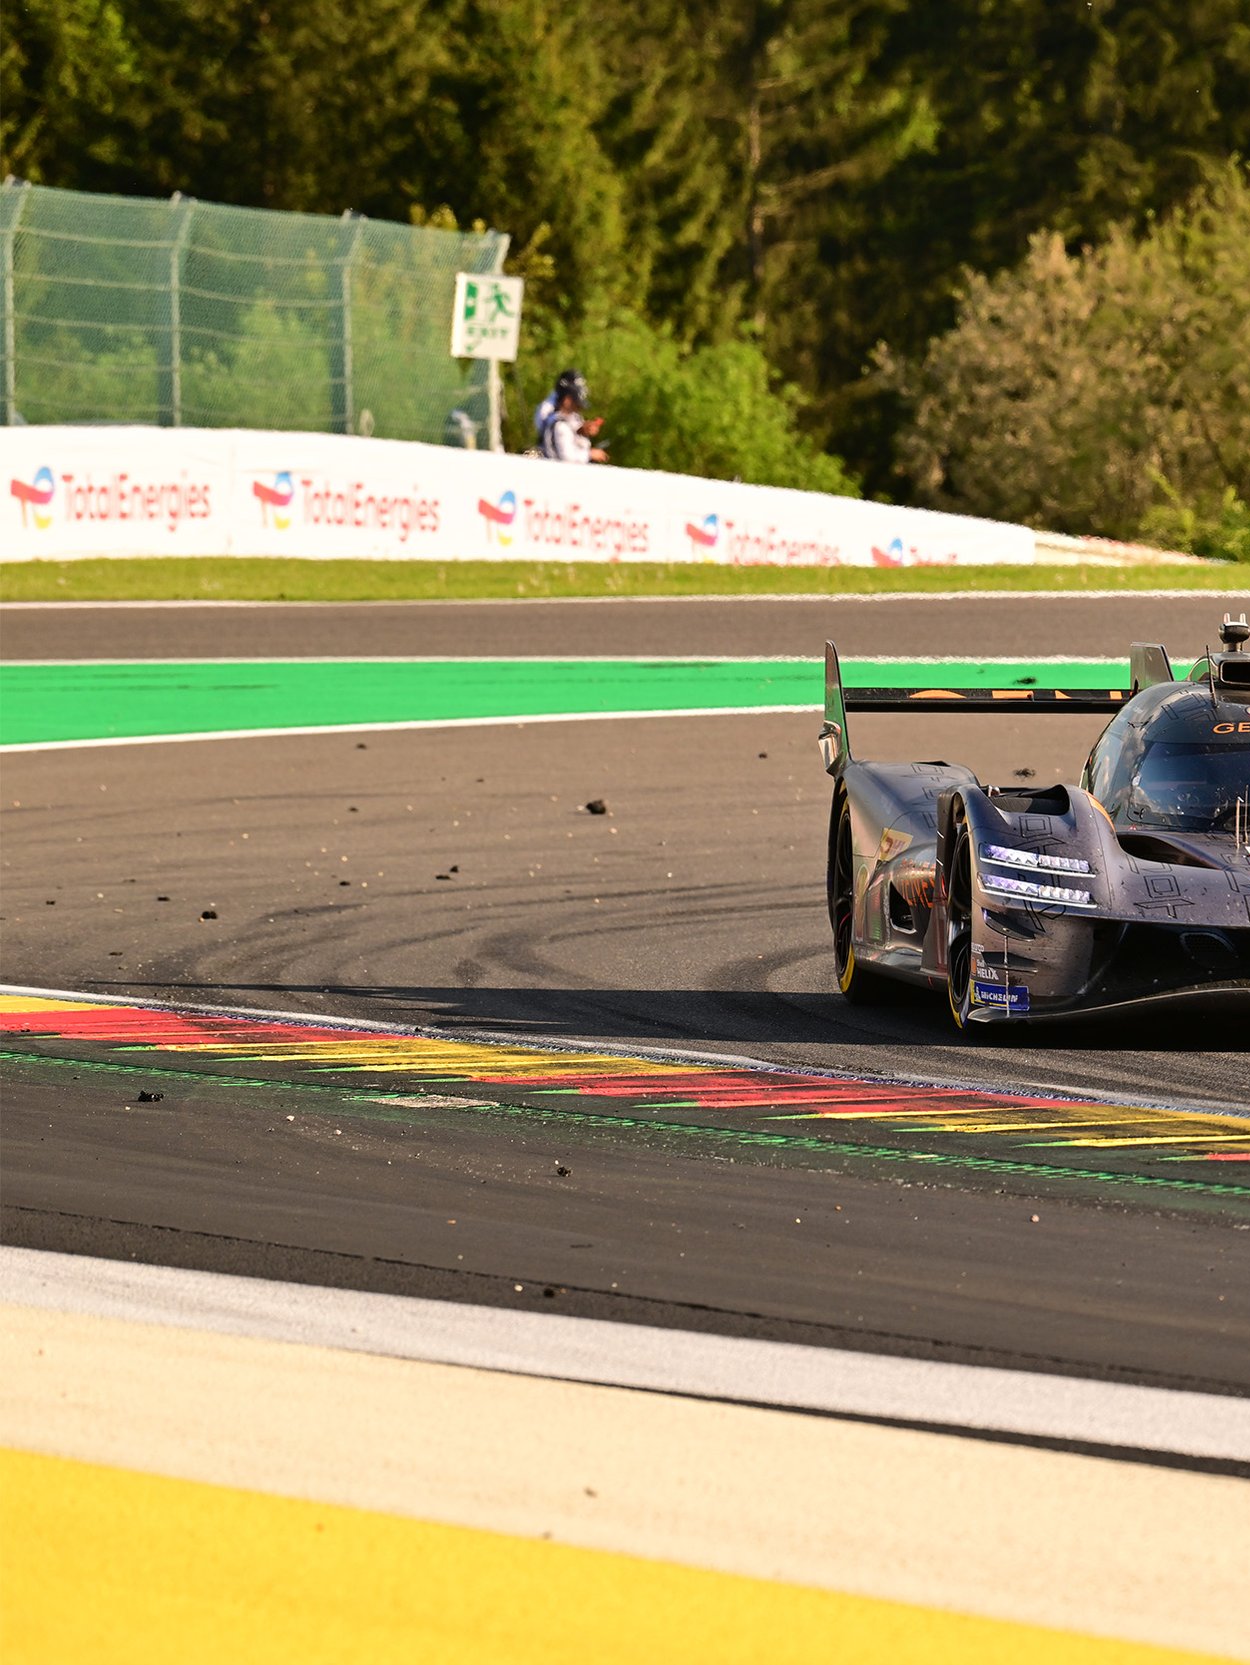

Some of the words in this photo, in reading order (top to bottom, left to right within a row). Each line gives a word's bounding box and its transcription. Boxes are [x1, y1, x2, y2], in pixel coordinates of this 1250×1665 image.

[61, 469, 211, 533] TotalEnergies
[301, 479, 440, 542] TotalEnergies
[524, 499, 648, 563] TotalEnergies
[976, 966, 999, 980] HELIX
[980, 990, 1019, 1003] MICHELIN
